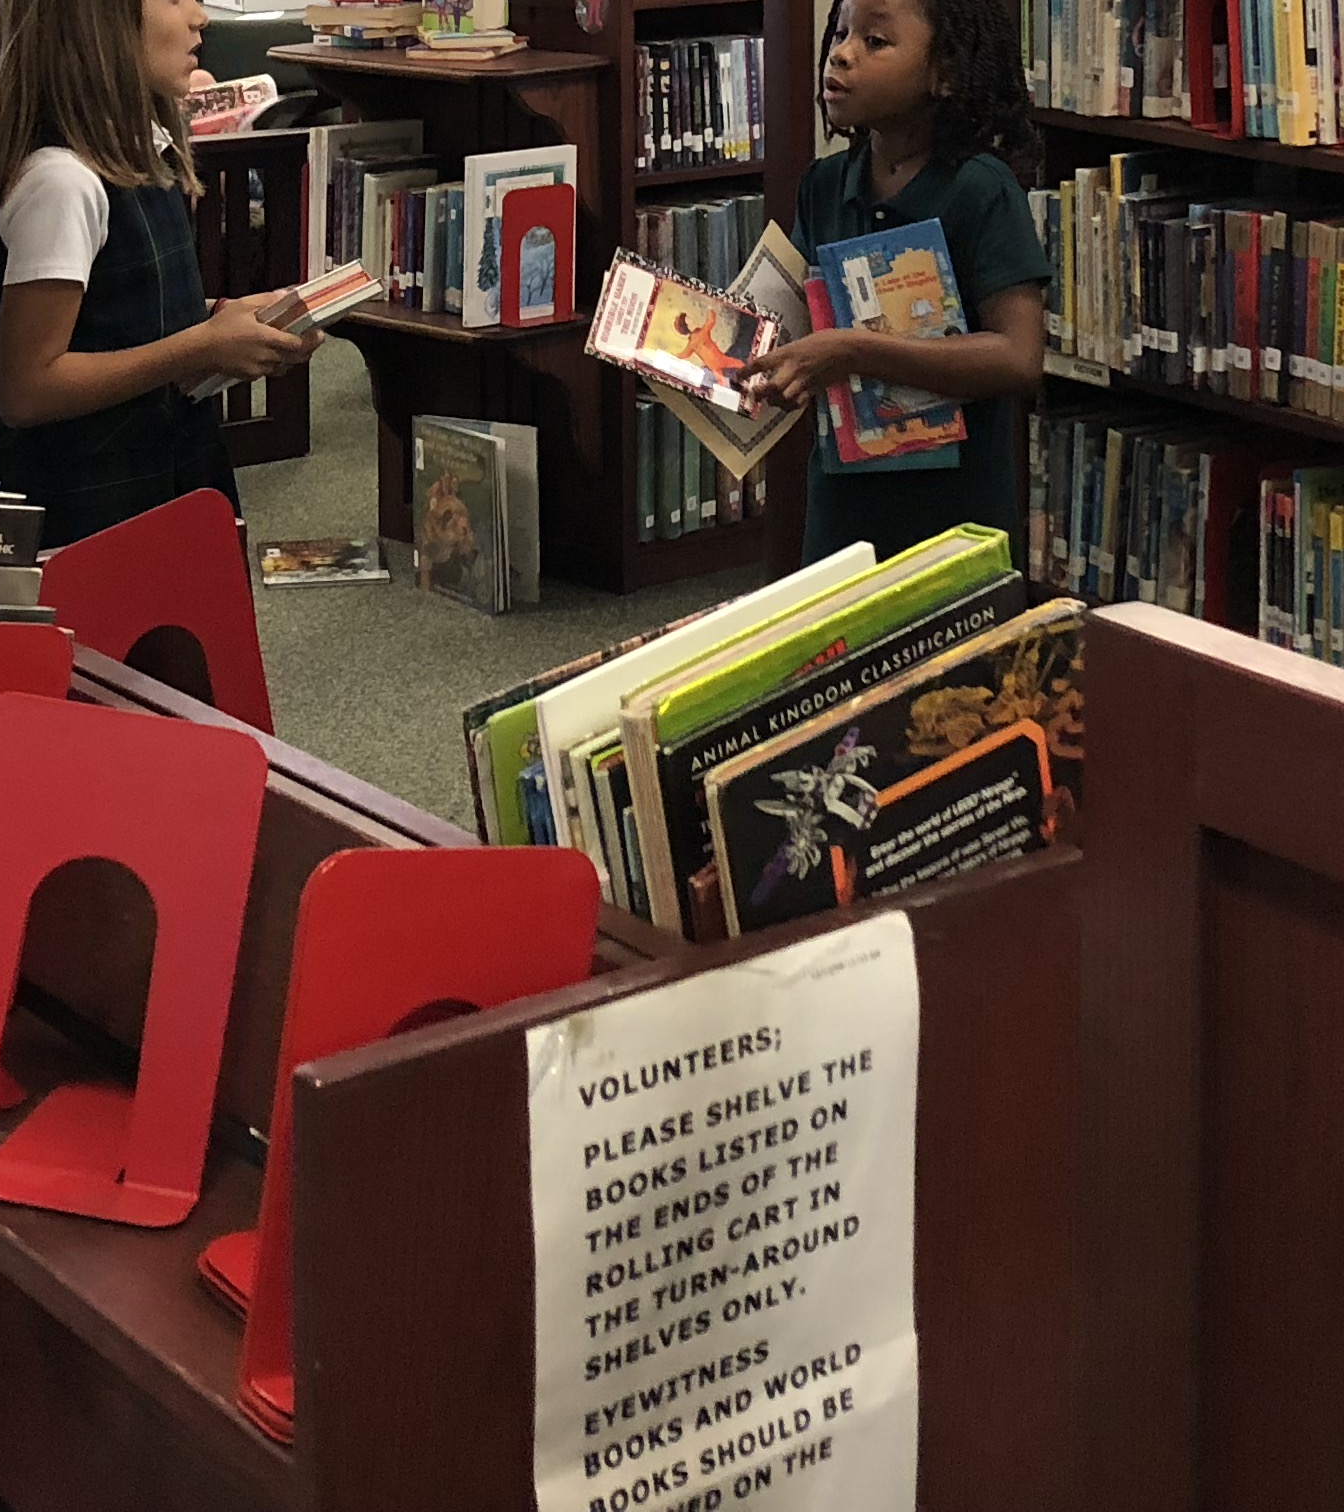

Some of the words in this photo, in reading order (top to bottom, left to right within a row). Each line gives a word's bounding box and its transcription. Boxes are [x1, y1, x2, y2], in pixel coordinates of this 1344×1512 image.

[691, 725, 761, 773] ANIMAL
[768, 678, 854, 734] KINGDOM
[860, 605, 997, 686] CLASSIFICATION
[583, 1111, 695, 1169] PLEASE
[706, 1070, 812, 1128] SHELVE
[822, 1048, 874, 1086] THE
[585, 1156, 687, 1213] BOOKS
[698, 1117, 800, 1173] LISTED
[810, 1098, 849, 1131] ON
[585, 1214, 642, 1254] THE
[654, 1181, 731, 1230] ENDS
[741, 1164, 778, 1197] OF
[787, 1141, 839, 1179] THE
[585, 1228, 715, 1298] ROLLING
[727, 1196, 800, 1241] CART
[809, 1180, 842, 1212] IN
[584, 1297, 641, 1339] THE
[651, 1215, 861, 1312] TURN-AROUND
[584, 1310, 712, 1382] SHELVES
[722, 1276, 807, 1324] ONLY.
[583, 1416, 683, 1480] BOOKS
[695, 1388, 753, 1432] AND
[763, 1342, 862, 1400] WORLD
[584, 1340, 770, 1437] EYEWITNESS
[588, 1460, 690, 1512] BOOKS
[699, 1407, 812, 1475] SHOULD
[822, 1387, 855, 1422] BE
[733, 1465, 773, 1500] ON
[782, 1436, 834, 1475] THE
